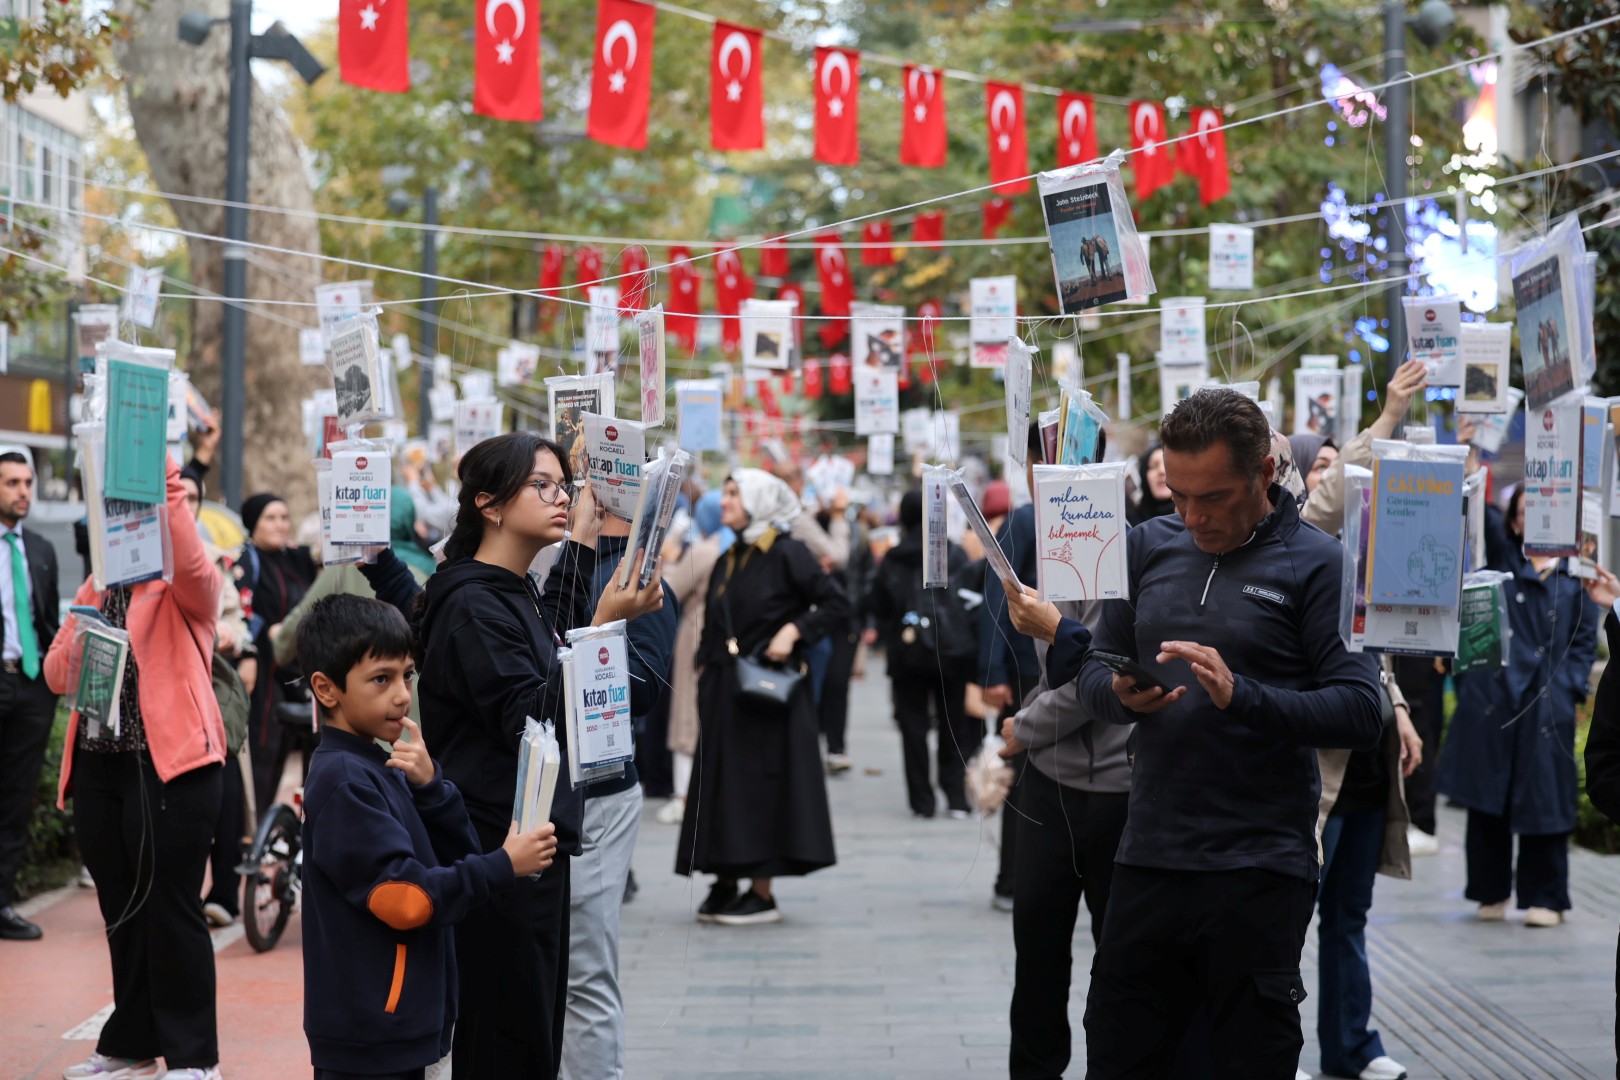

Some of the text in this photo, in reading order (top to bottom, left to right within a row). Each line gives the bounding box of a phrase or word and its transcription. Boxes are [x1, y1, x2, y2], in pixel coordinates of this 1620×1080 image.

[1070, 192, 1098, 203] Steinbeck
[1412, 336, 1434, 349] kitap
[588, 454, 639, 477] kitap fuarı
[1526, 456, 1572, 482] kitap fuarı
[336, 485, 386, 502] kitap fuarı
[1049, 486, 1089, 506] milan
[1060, 504, 1114, 524] kundera
[1386, 507, 1417, 517] Kentler
[1048, 524, 1104, 542] bilmemek
[1376, 604, 1392, 613] 1050
[583, 689, 607, 708] kitap
